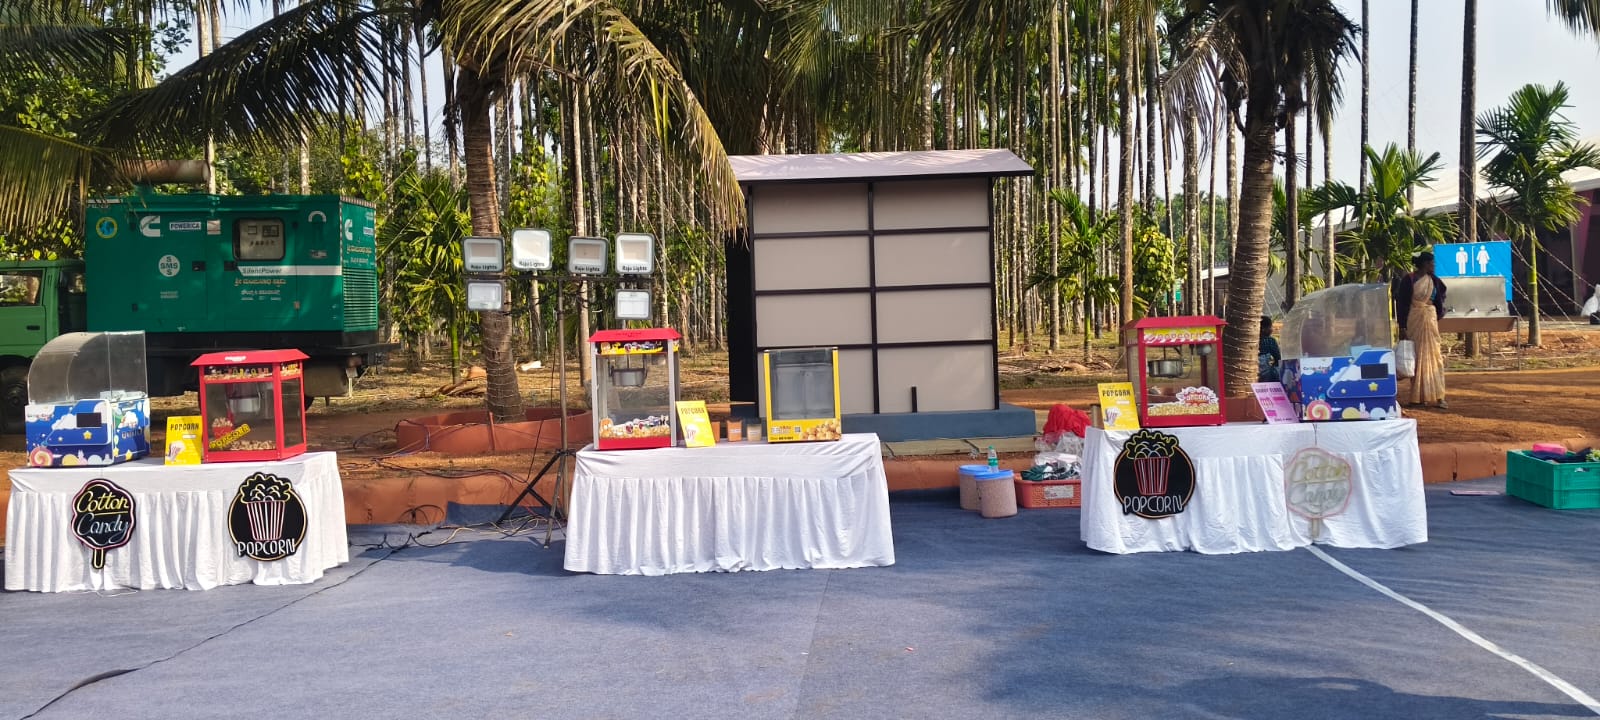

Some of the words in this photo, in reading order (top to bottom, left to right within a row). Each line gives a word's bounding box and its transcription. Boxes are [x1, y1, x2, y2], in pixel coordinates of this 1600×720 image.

[1102, 389, 1131, 397] POPCORN
[680, 407, 705, 415] POPCORN
[170, 423, 200, 431] POPCORN
[77, 491, 129, 513] Cotton
[1123, 495, 1183, 512] POPCORN
[77, 513, 129, 544] Candy
[237, 538, 296, 556] POPCORN
